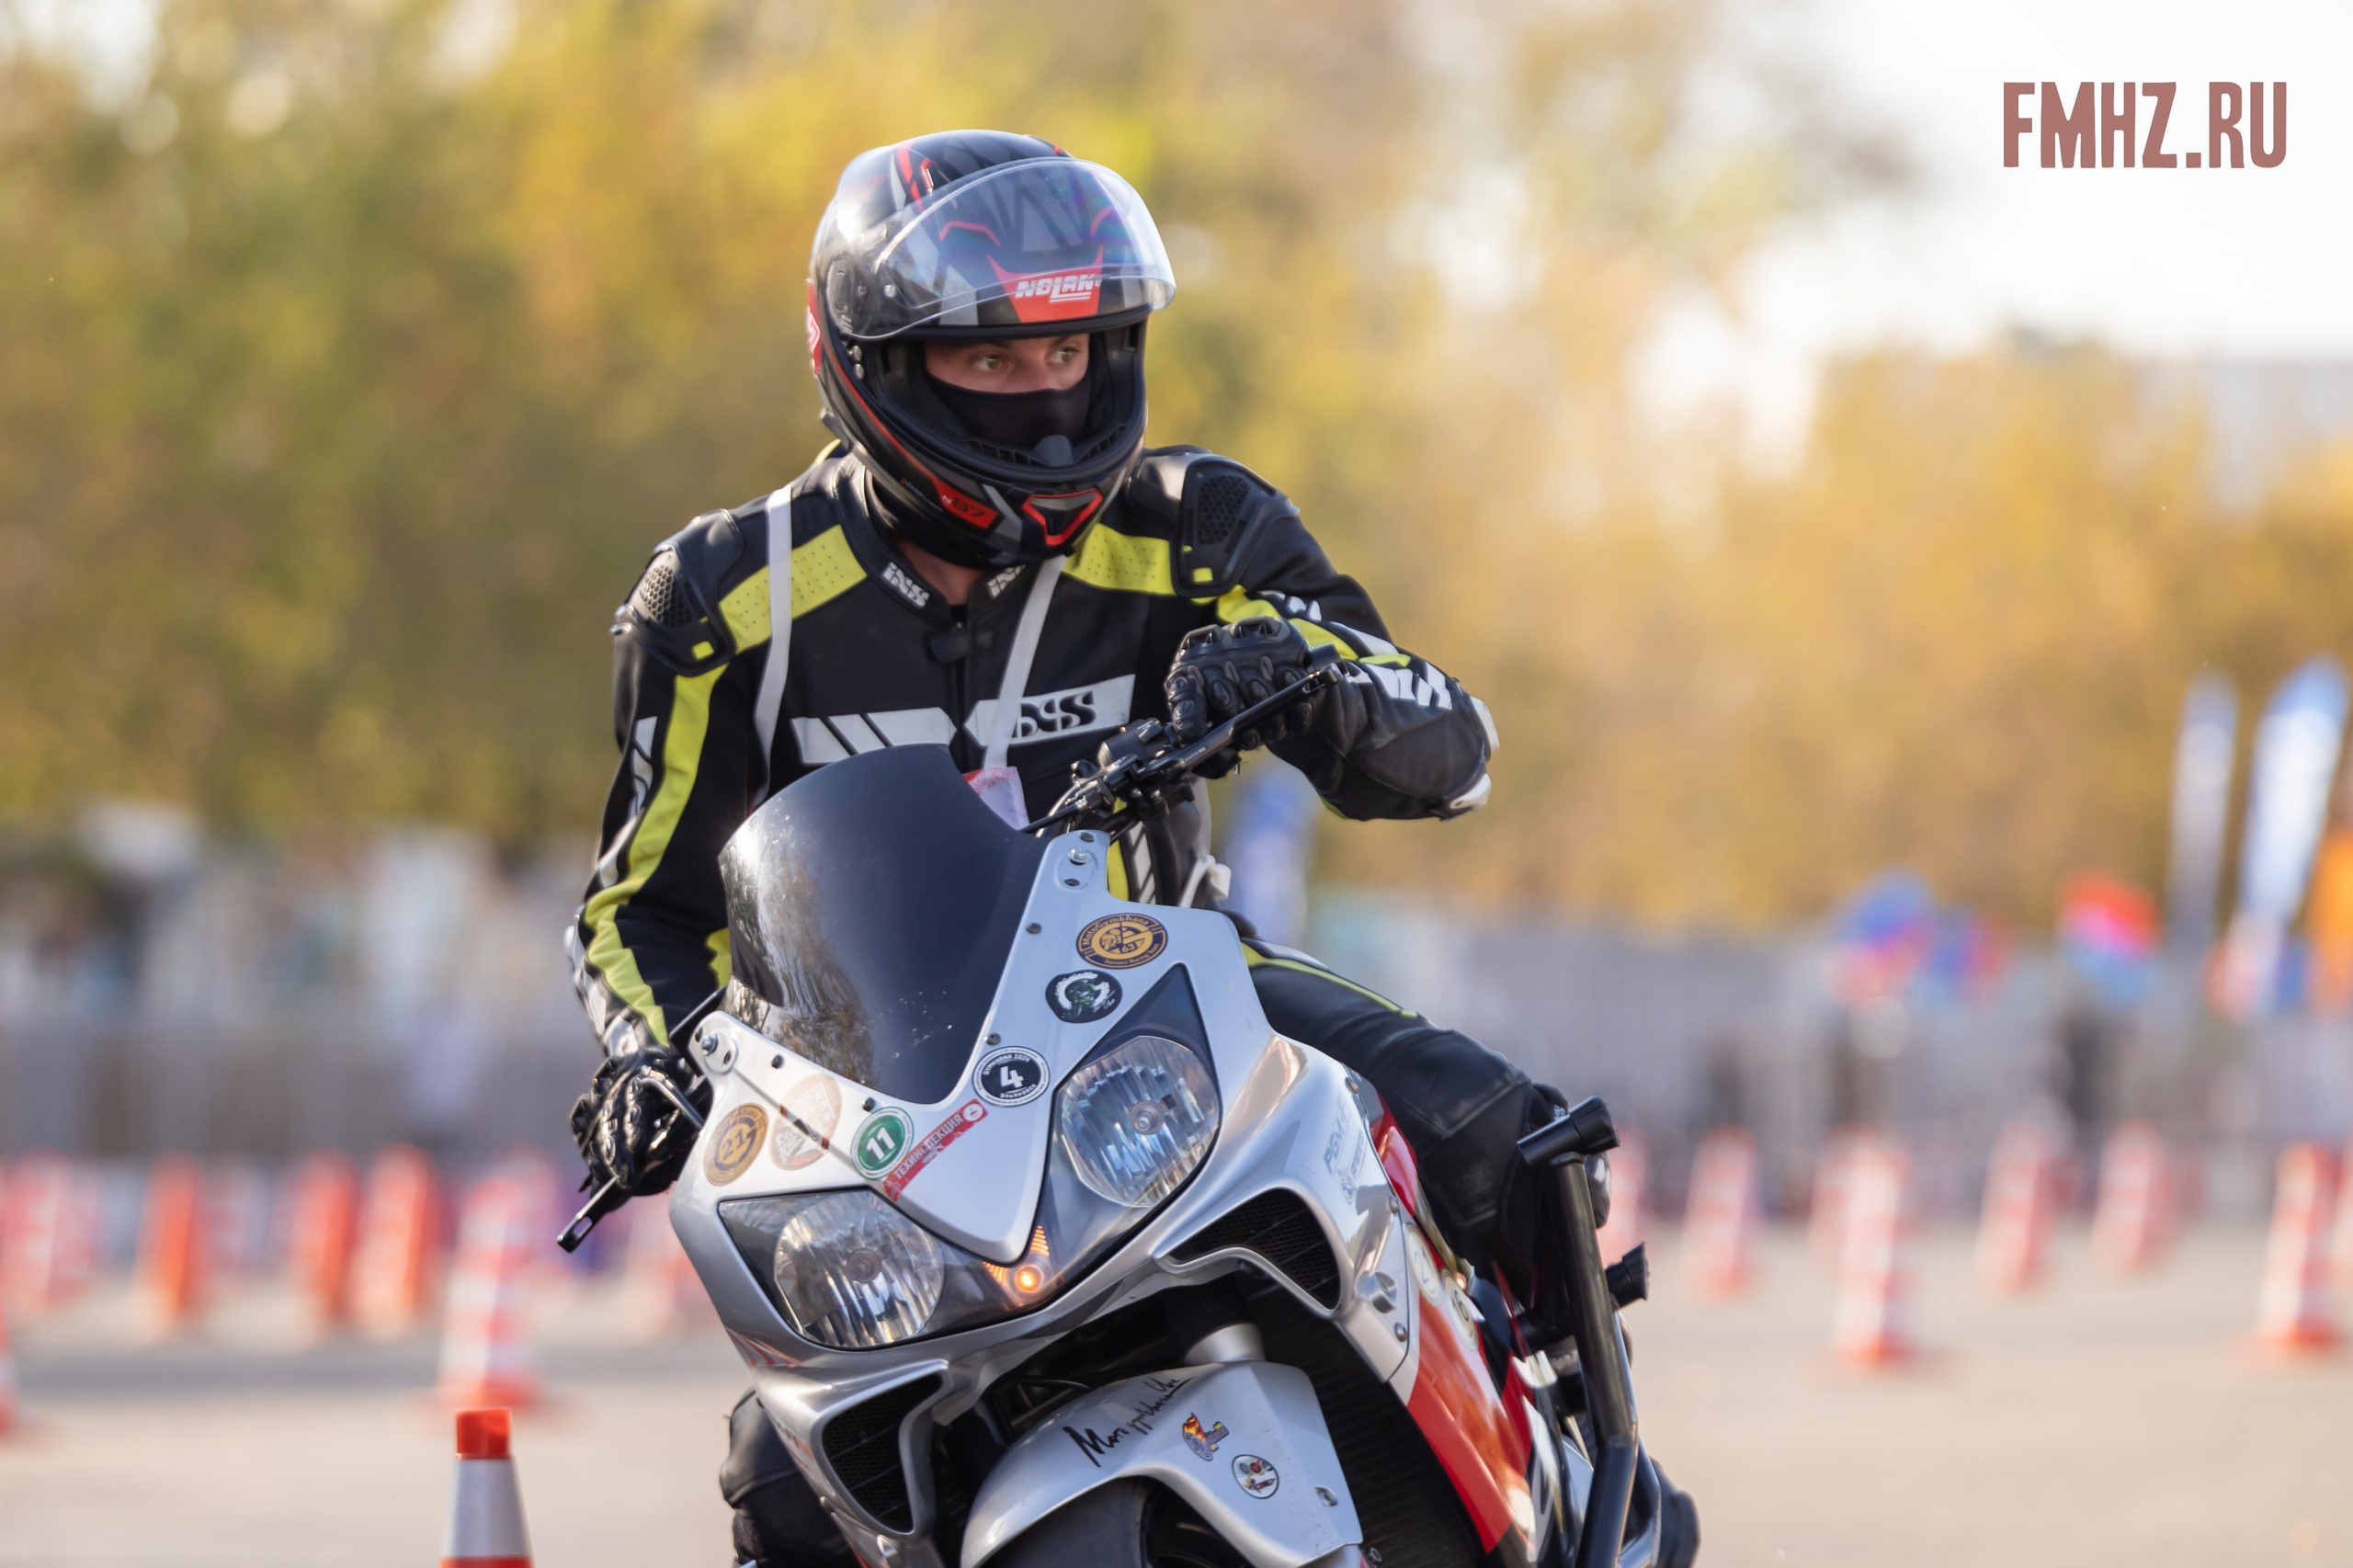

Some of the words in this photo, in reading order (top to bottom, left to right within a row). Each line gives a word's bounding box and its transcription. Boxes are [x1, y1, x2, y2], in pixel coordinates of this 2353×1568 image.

[1015, 274, 1097, 303] NOLAN
[1082, 915, 1149, 946] MotoGymkhana
[1122, 943, 1136, 953] 63
[1000, 1065, 1025, 1088] 4
[866, 1127, 897, 1161] 11
[893, 1114, 965, 1180] ТЕХИНСПЕКЦИЯ
